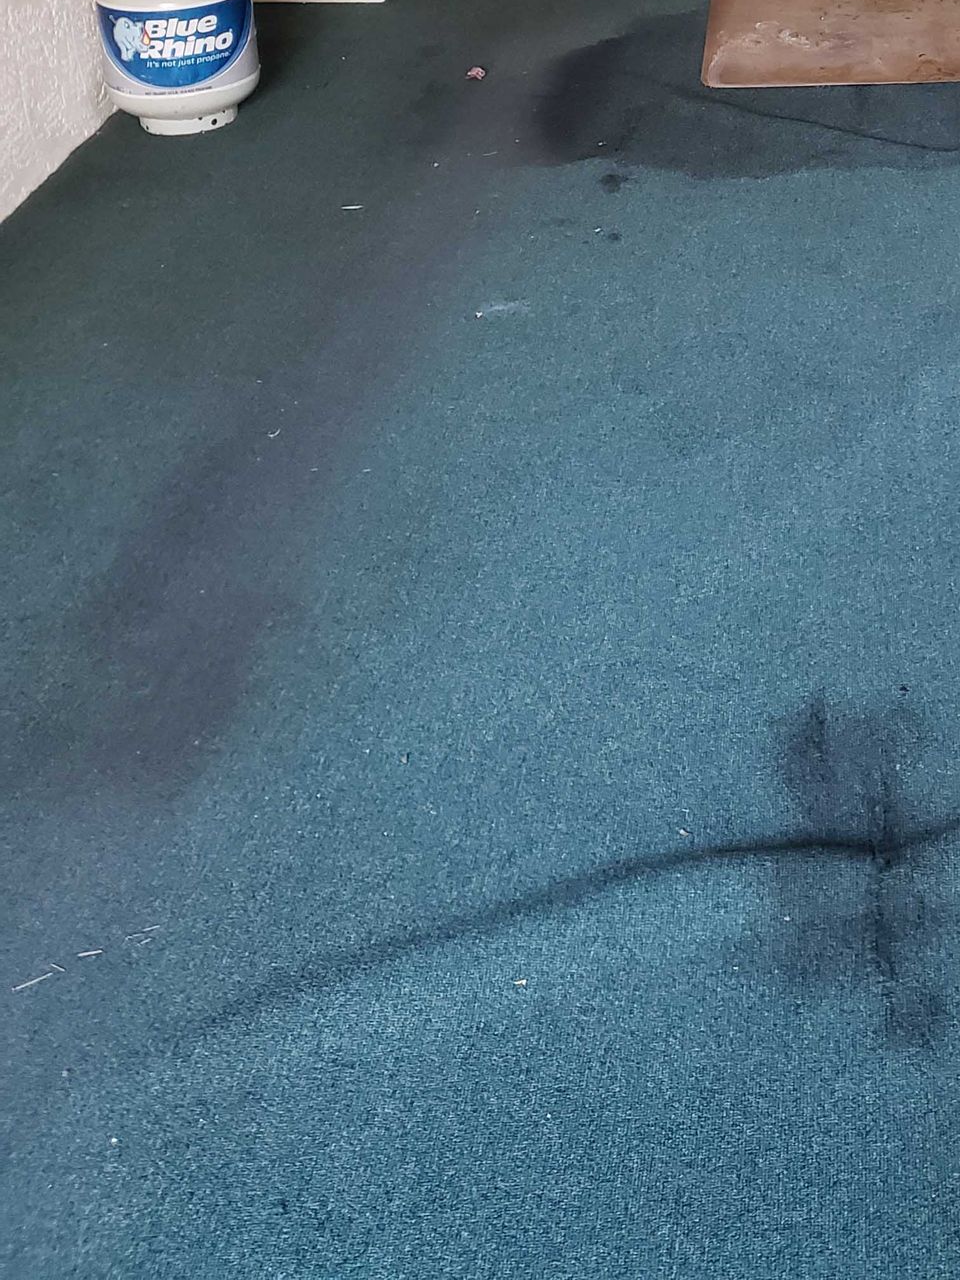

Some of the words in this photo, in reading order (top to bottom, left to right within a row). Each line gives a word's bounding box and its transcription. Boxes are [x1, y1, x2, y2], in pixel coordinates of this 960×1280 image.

[145, 15, 217, 38] Blue
[140, 31, 233, 60] Rhino
[178, 58, 195, 68] just
